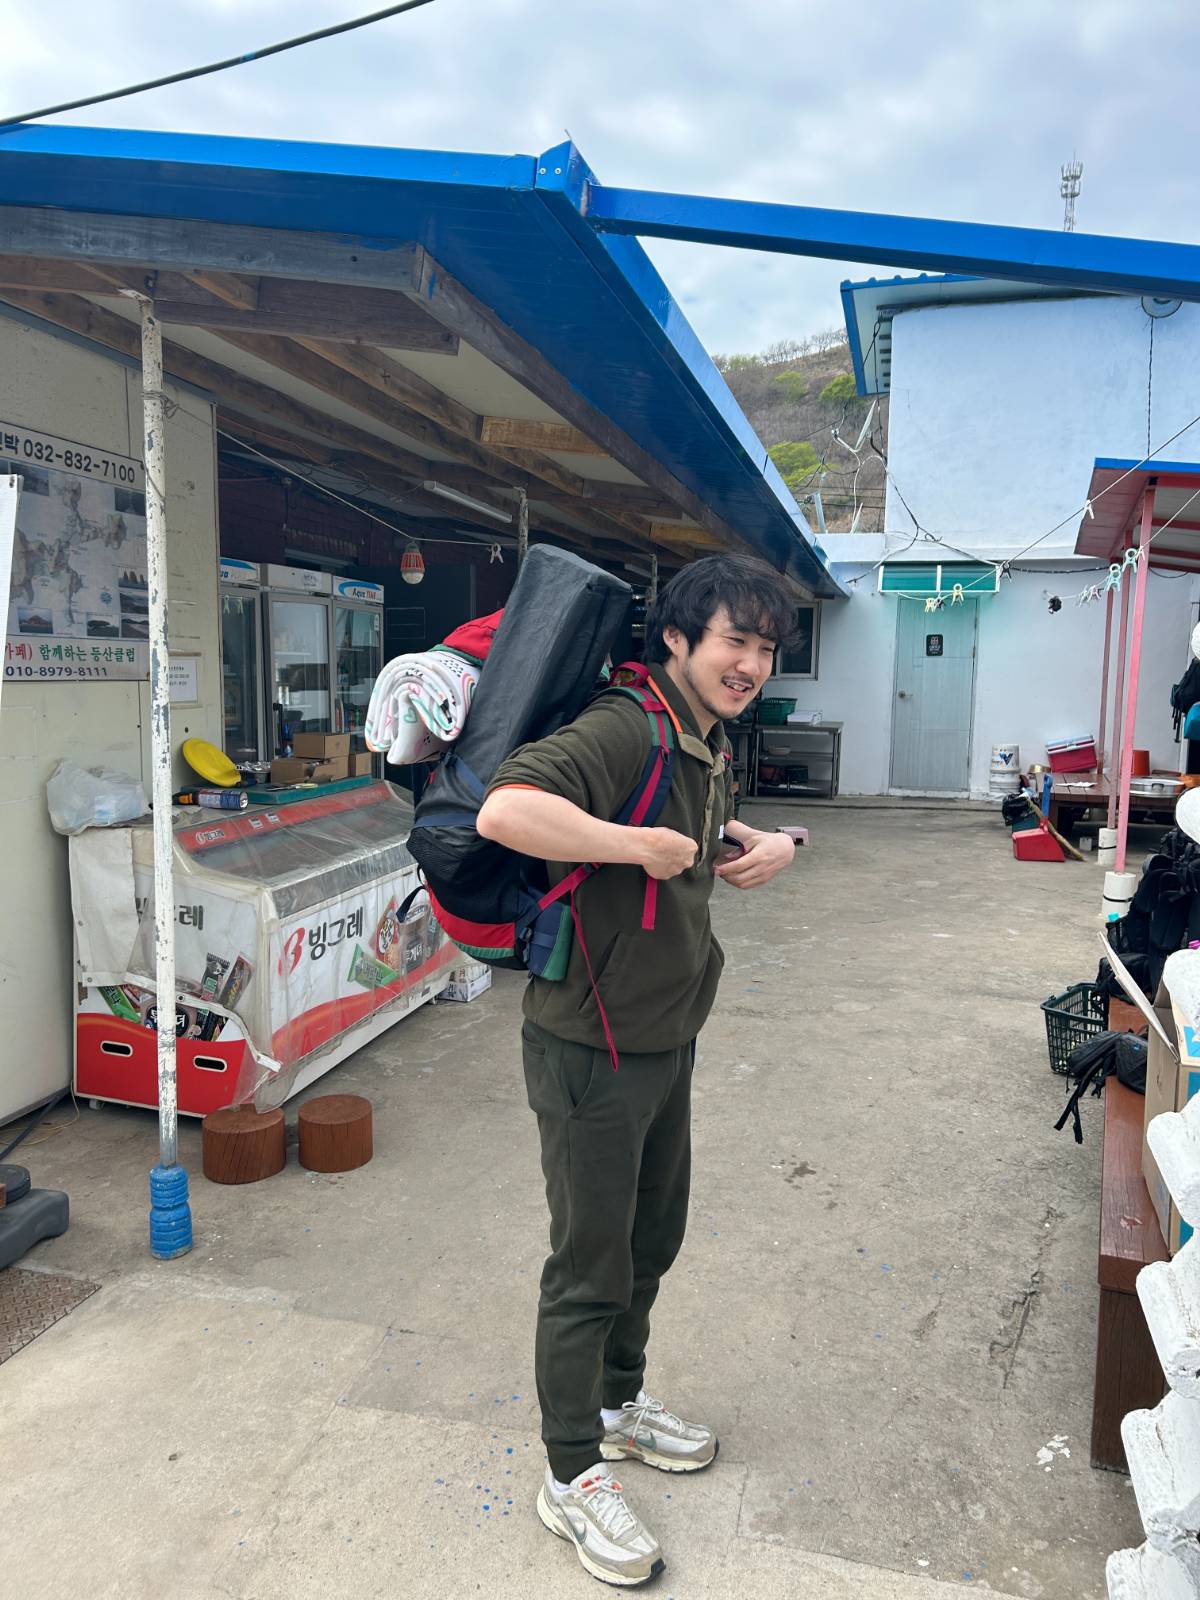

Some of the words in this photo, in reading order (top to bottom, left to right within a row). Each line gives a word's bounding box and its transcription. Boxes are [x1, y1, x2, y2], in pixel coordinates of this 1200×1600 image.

[23, 439, 135, 483] 032-832-7100
[39, 643, 87, 662] 함께하는
[90, 646, 135, 663] 등산클럽
[5, 666, 108, 677] 010-8979-8111
[308, 906, 364, 961] 빙그레
[150, 1008, 186, 1029] 투더
